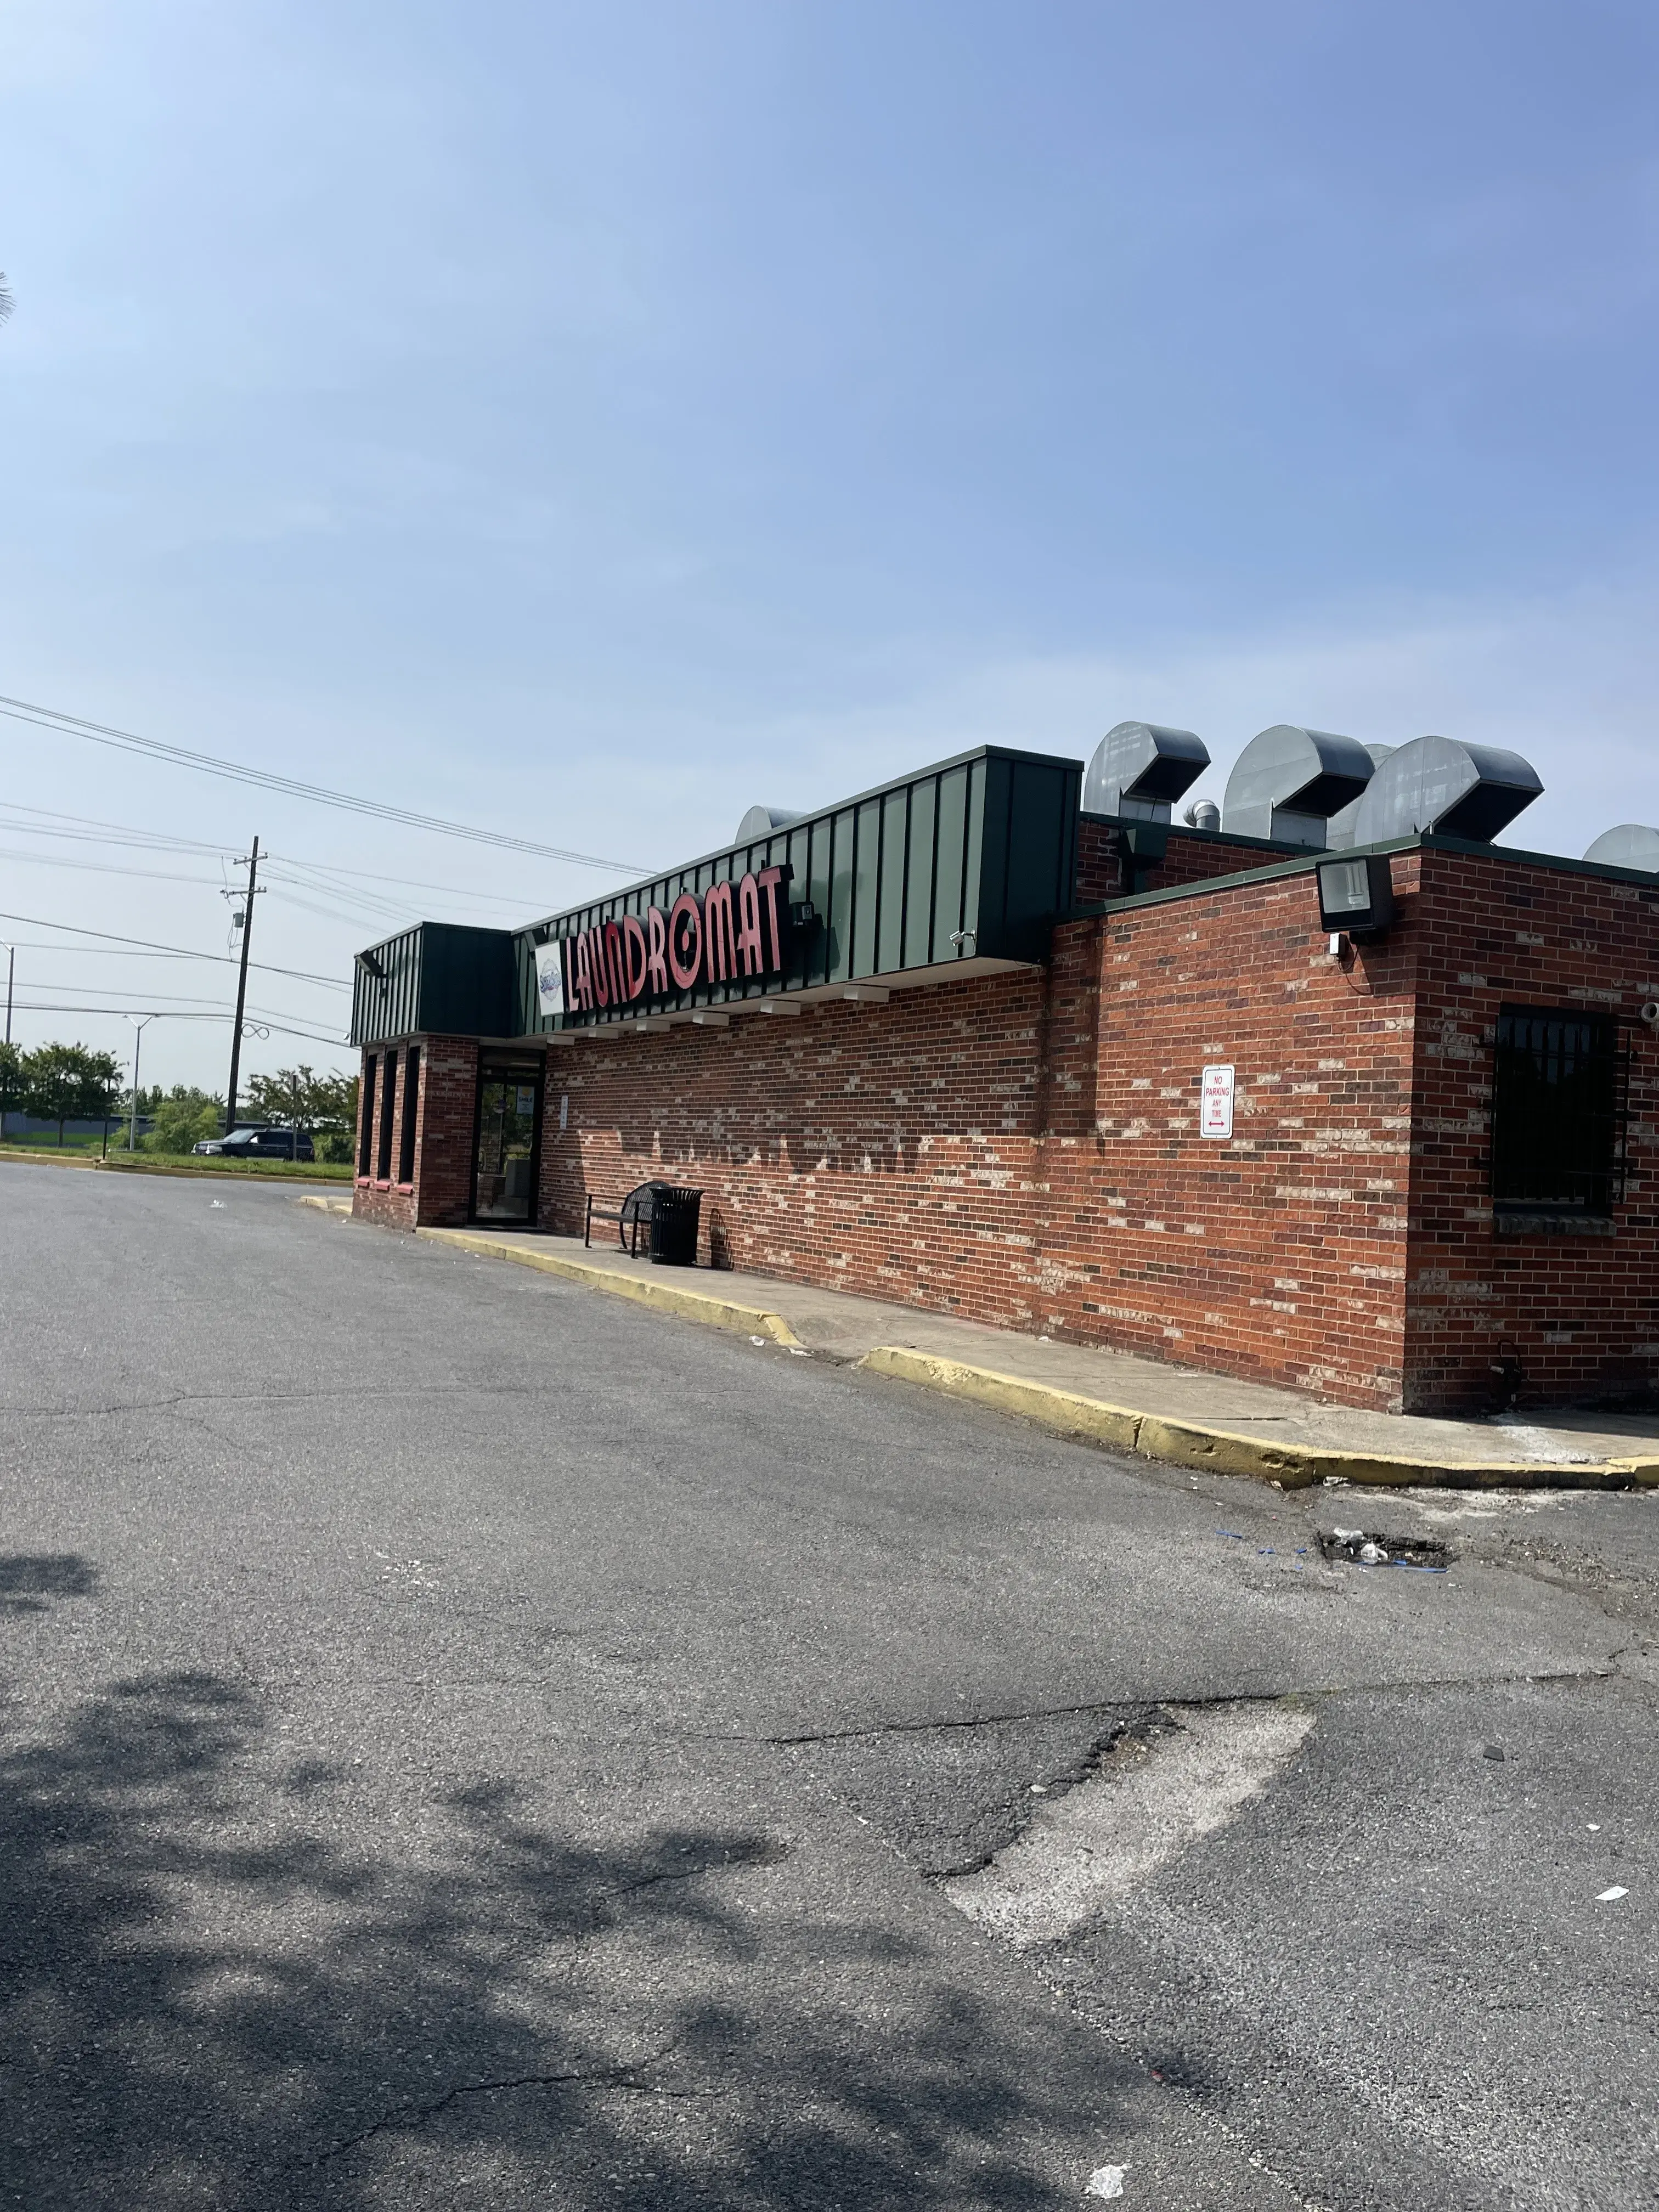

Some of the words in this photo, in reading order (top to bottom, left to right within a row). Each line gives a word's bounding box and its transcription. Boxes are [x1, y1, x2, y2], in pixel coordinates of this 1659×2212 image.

[566, 865, 782, 1012] LAUNDROMAT
[1214, 1076, 1222, 1084] NO
[1206, 1087, 1229, 1096] PARKING
